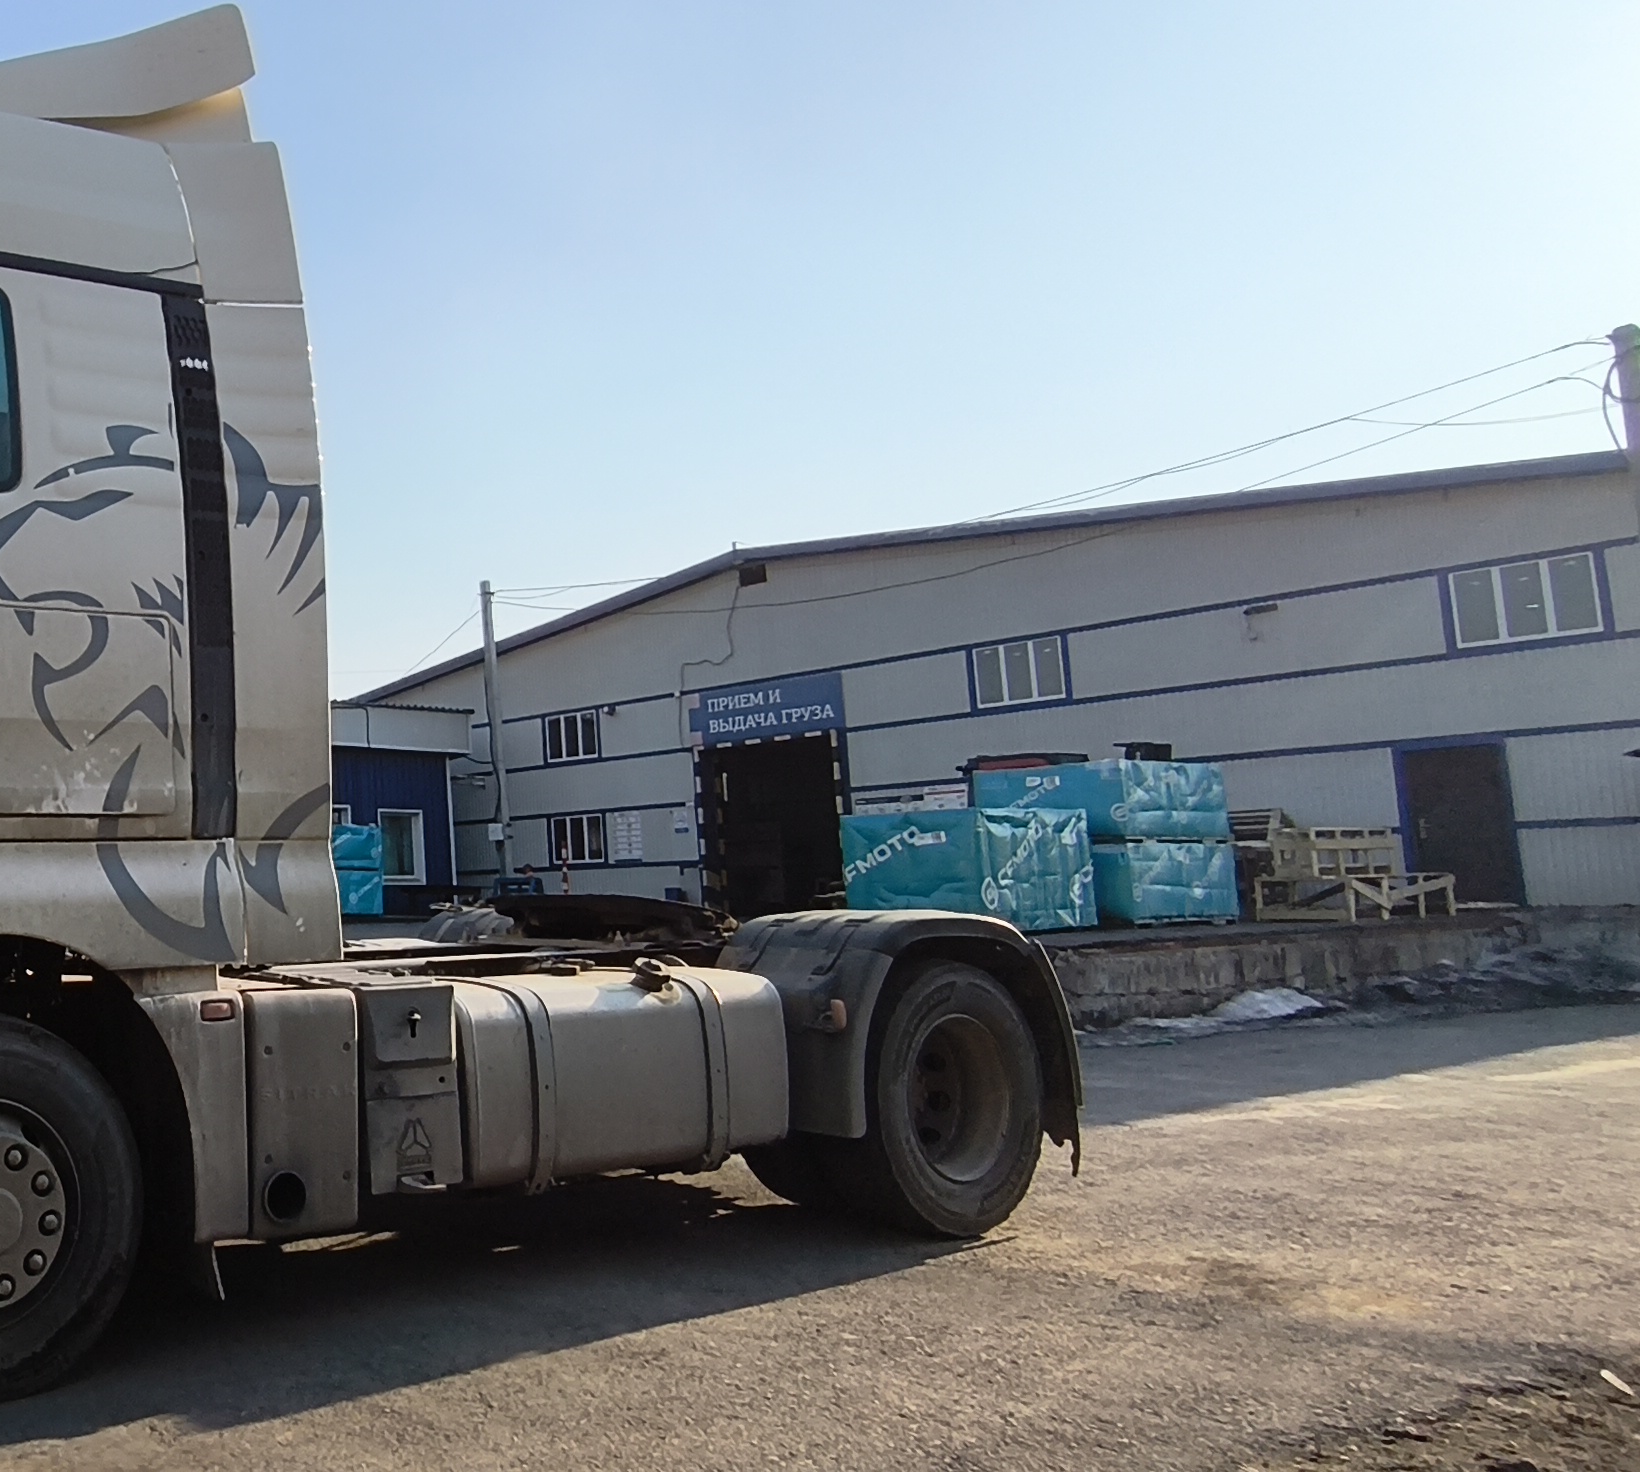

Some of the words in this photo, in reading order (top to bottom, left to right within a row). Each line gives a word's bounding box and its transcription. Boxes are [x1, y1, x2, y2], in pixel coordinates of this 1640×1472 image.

[707, 691, 763, 712] ПРИЕМ
[768, 689, 781, 704] И
[709, 712, 778, 733] ВЫДАЧА
[781, 704, 834, 724] ГРУЗА
[843, 826, 920, 886] FMOTO
